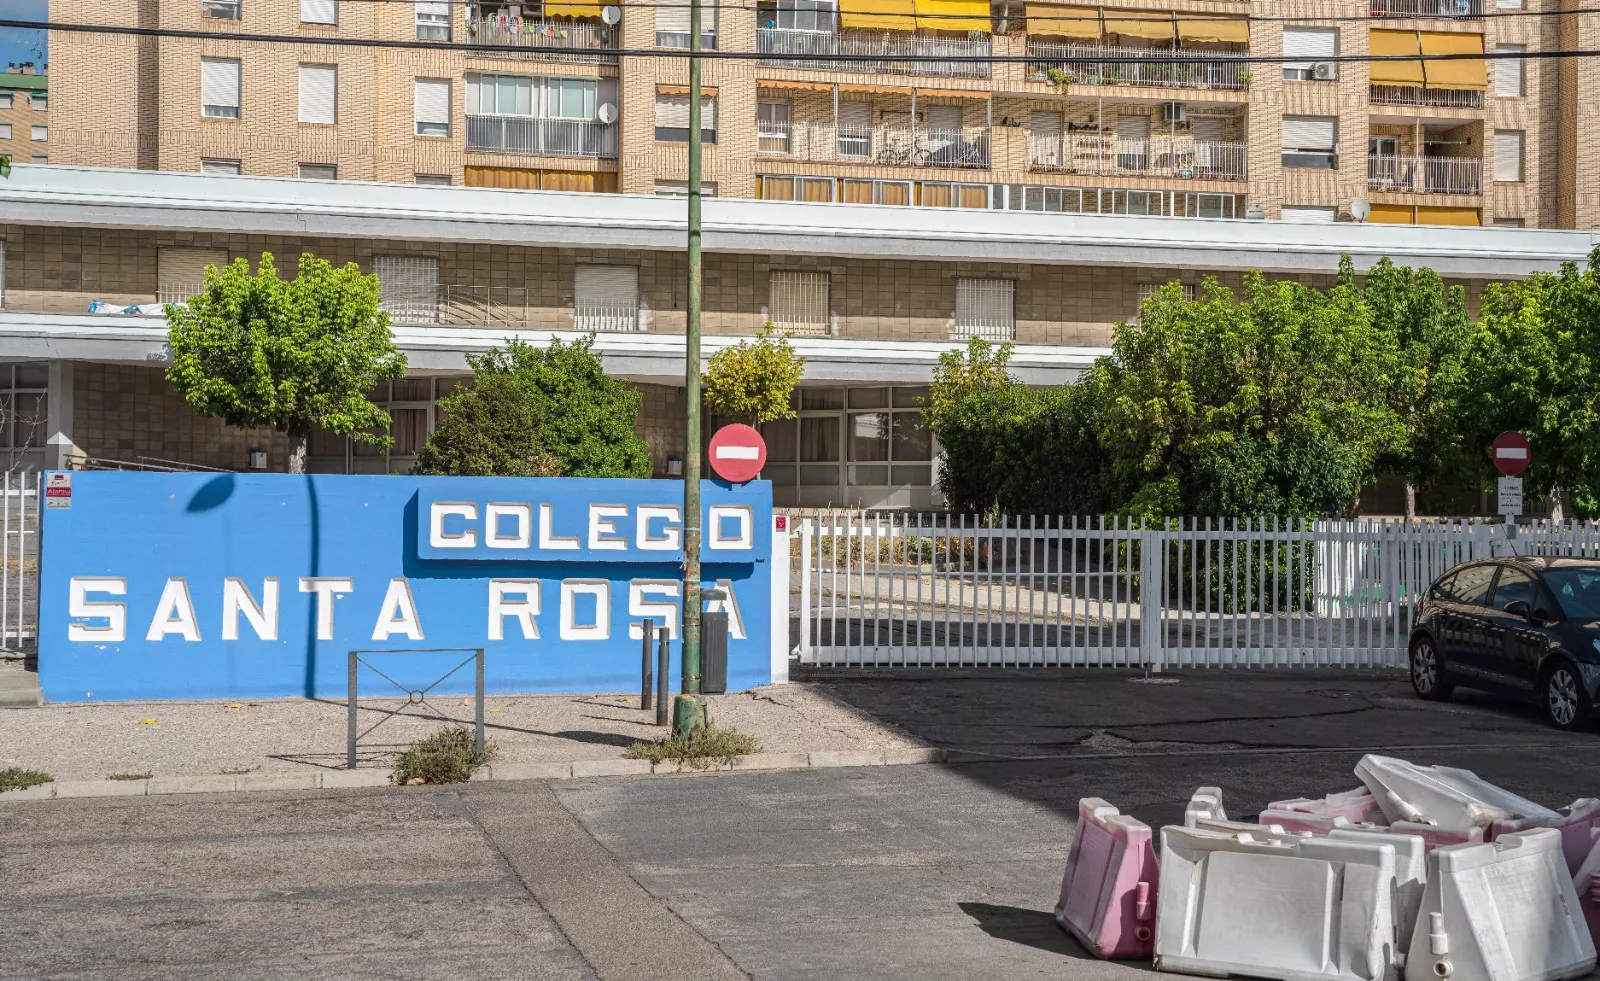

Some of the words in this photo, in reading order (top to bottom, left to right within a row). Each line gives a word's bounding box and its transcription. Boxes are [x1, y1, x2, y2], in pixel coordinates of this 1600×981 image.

[430, 502, 754, 551] COLEGO
[68, 576, 424, 642] SANTA
[488, 578, 747, 641] ROSA
